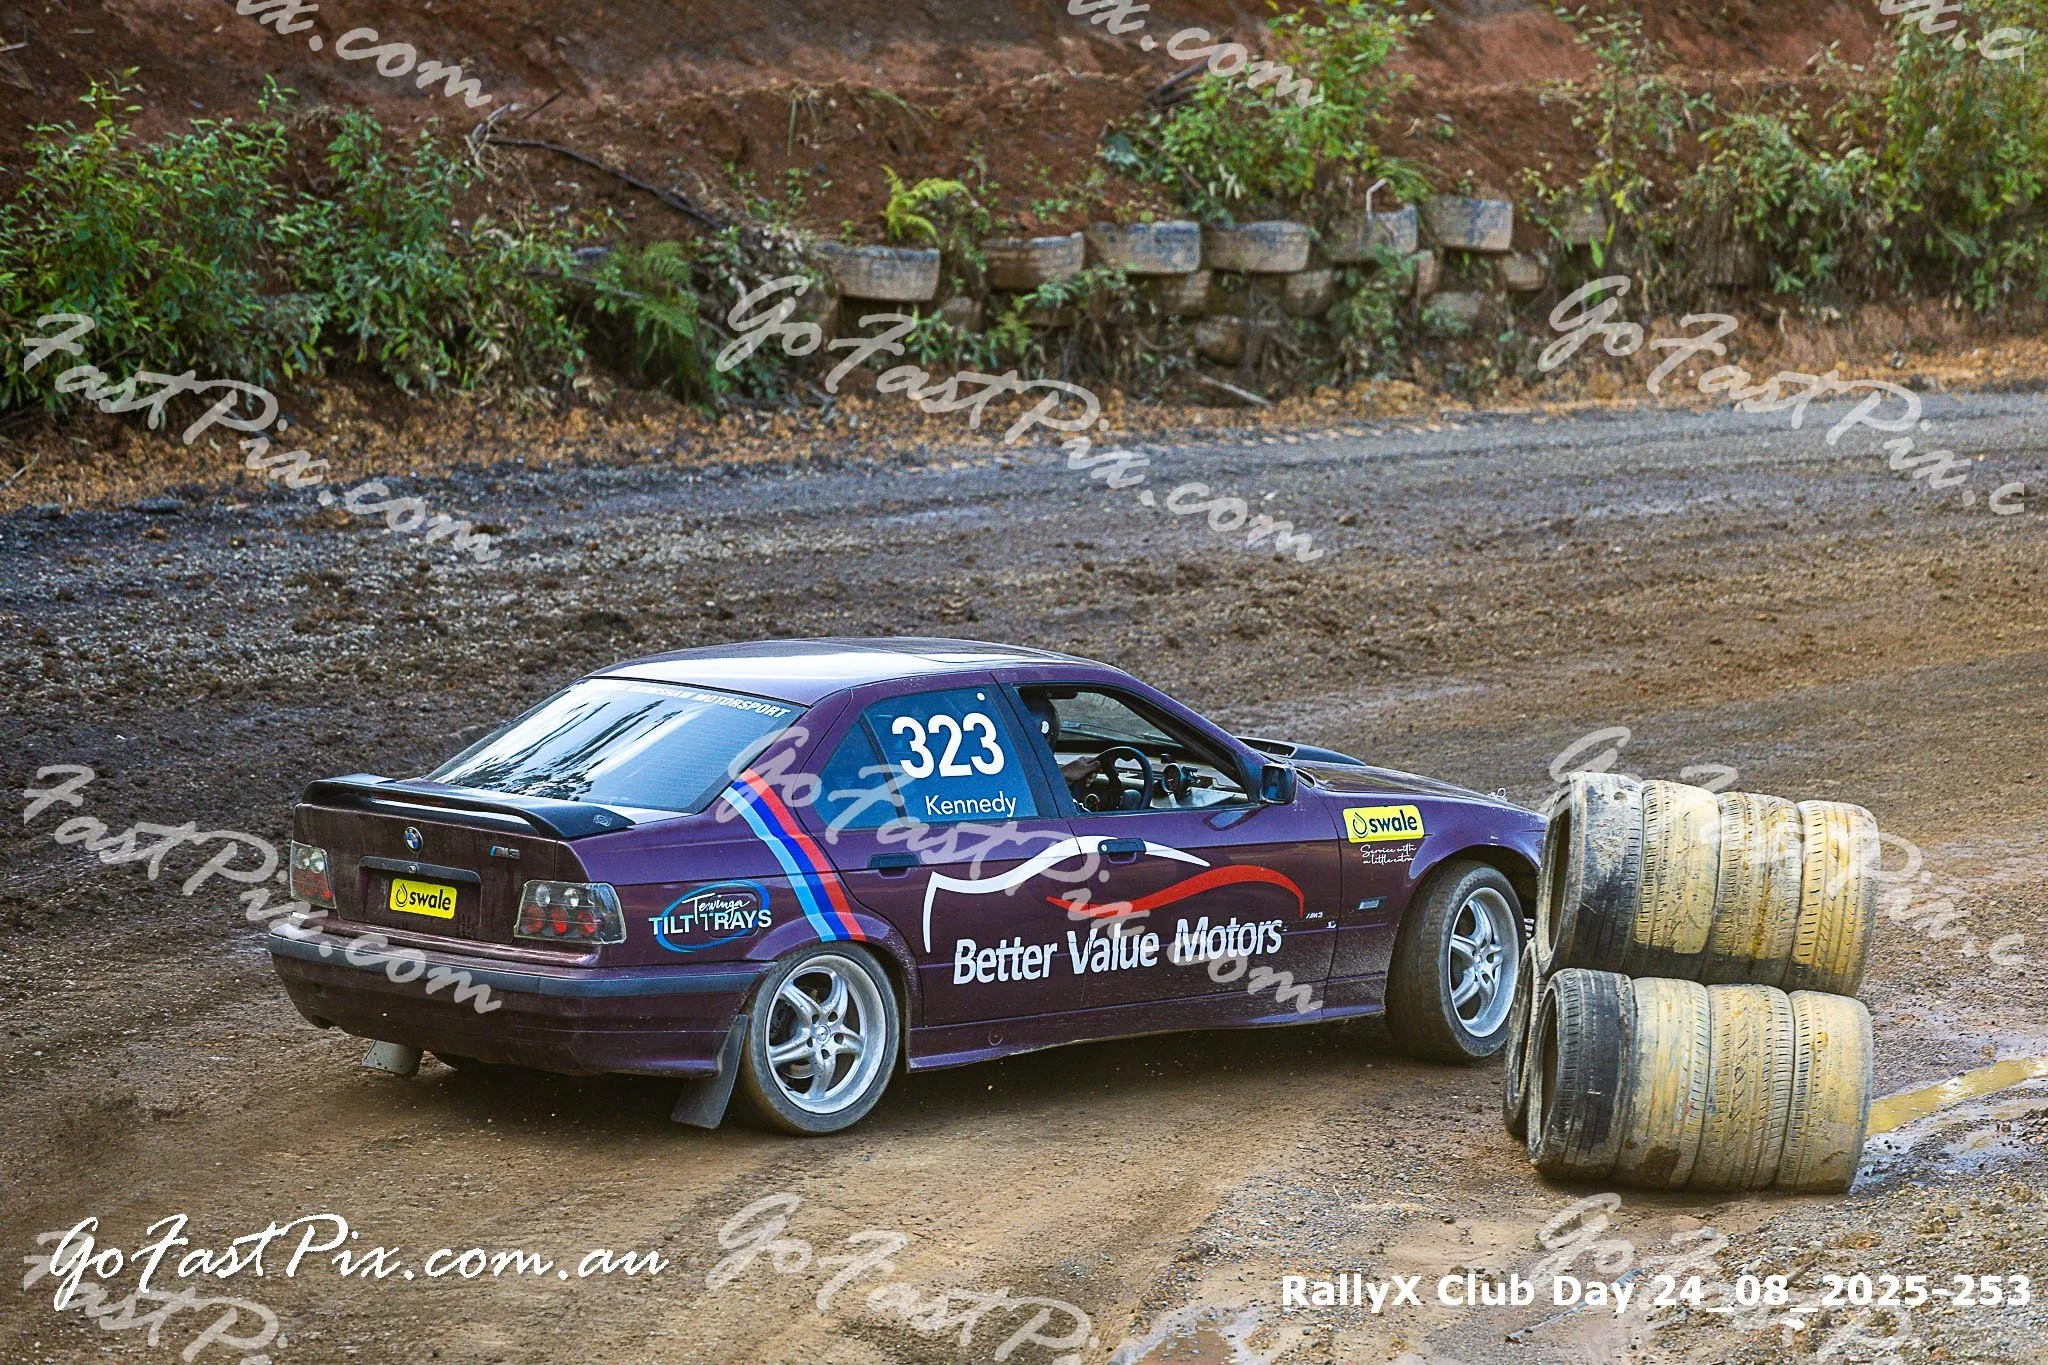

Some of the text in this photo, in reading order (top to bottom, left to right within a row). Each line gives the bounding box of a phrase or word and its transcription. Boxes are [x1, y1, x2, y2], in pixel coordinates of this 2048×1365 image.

[694, 692, 792, 718] MOTORSPORT
[892, 713, 1005, 779] 323
[924, 791, 1017, 817] Kennedy
[1369, 809, 1418, 833] swale
[409, 890, 451, 911] swale
[648, 909, 772, 935] TILT TRAYS
[953, 916, 1284, 985] Better Value Motors
